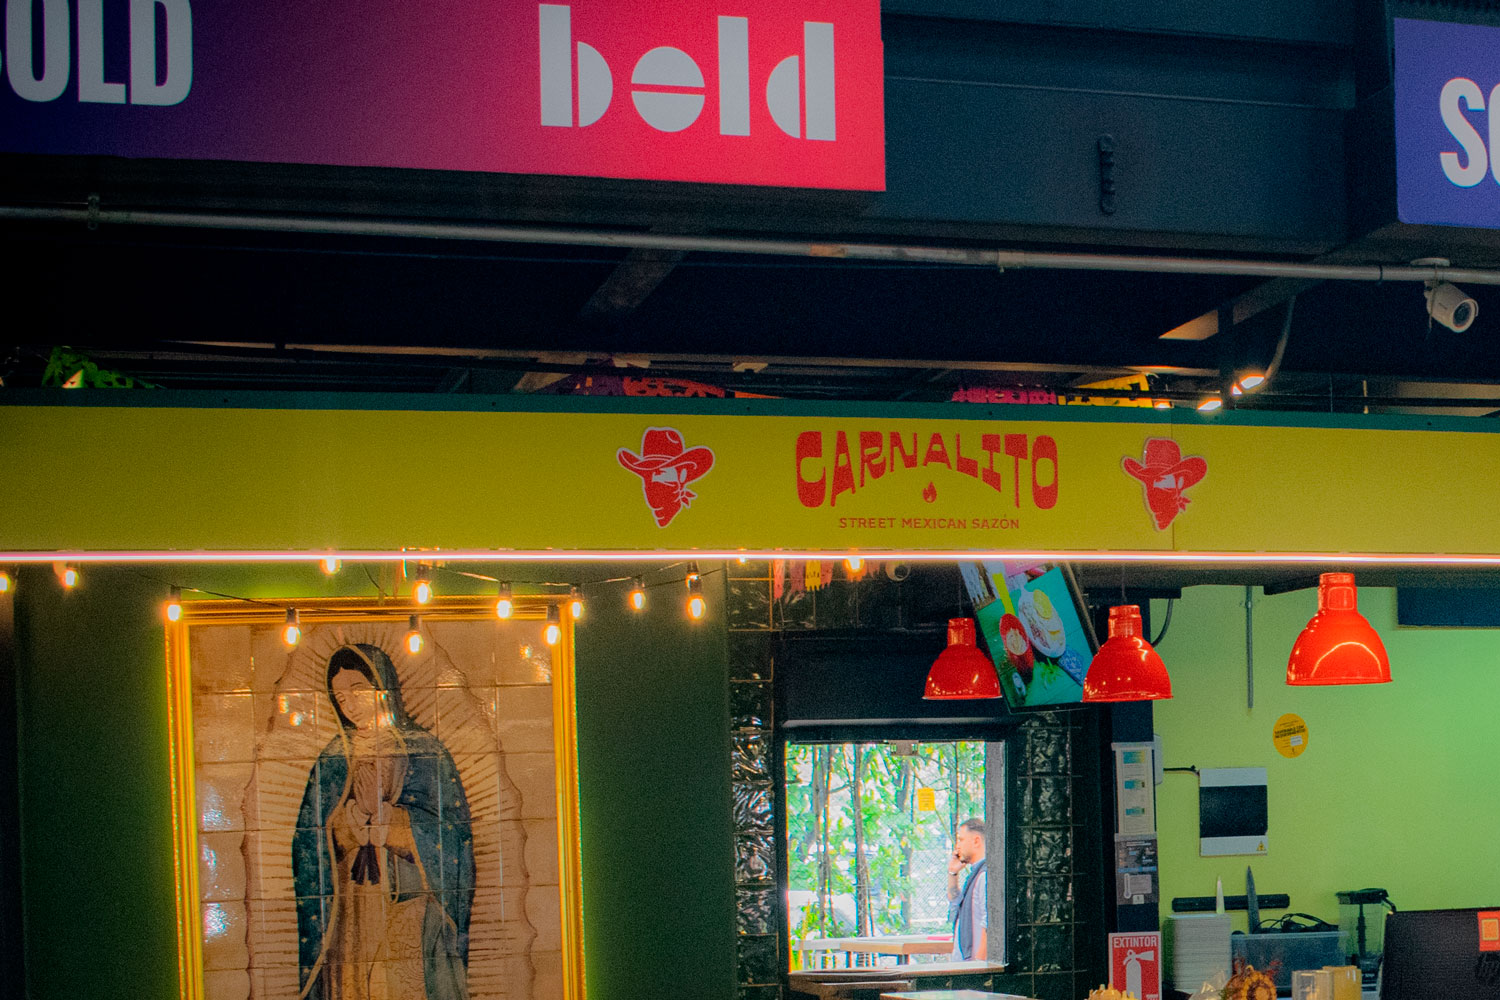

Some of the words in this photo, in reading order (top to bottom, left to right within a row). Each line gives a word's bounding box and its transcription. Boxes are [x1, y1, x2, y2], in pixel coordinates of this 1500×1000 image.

[0, 0, 193, 106] OLD
[539, 4, 836, 141] bold
[796, 430, 1058, 510] CARNALITO
[839, 517, 896, 529] STREET
[901, 517, 967, 529] MEXICAN
[971, 513, 1020, 529] SAZÓN
[1113, 936, 1157, 948] EXTINTOR
